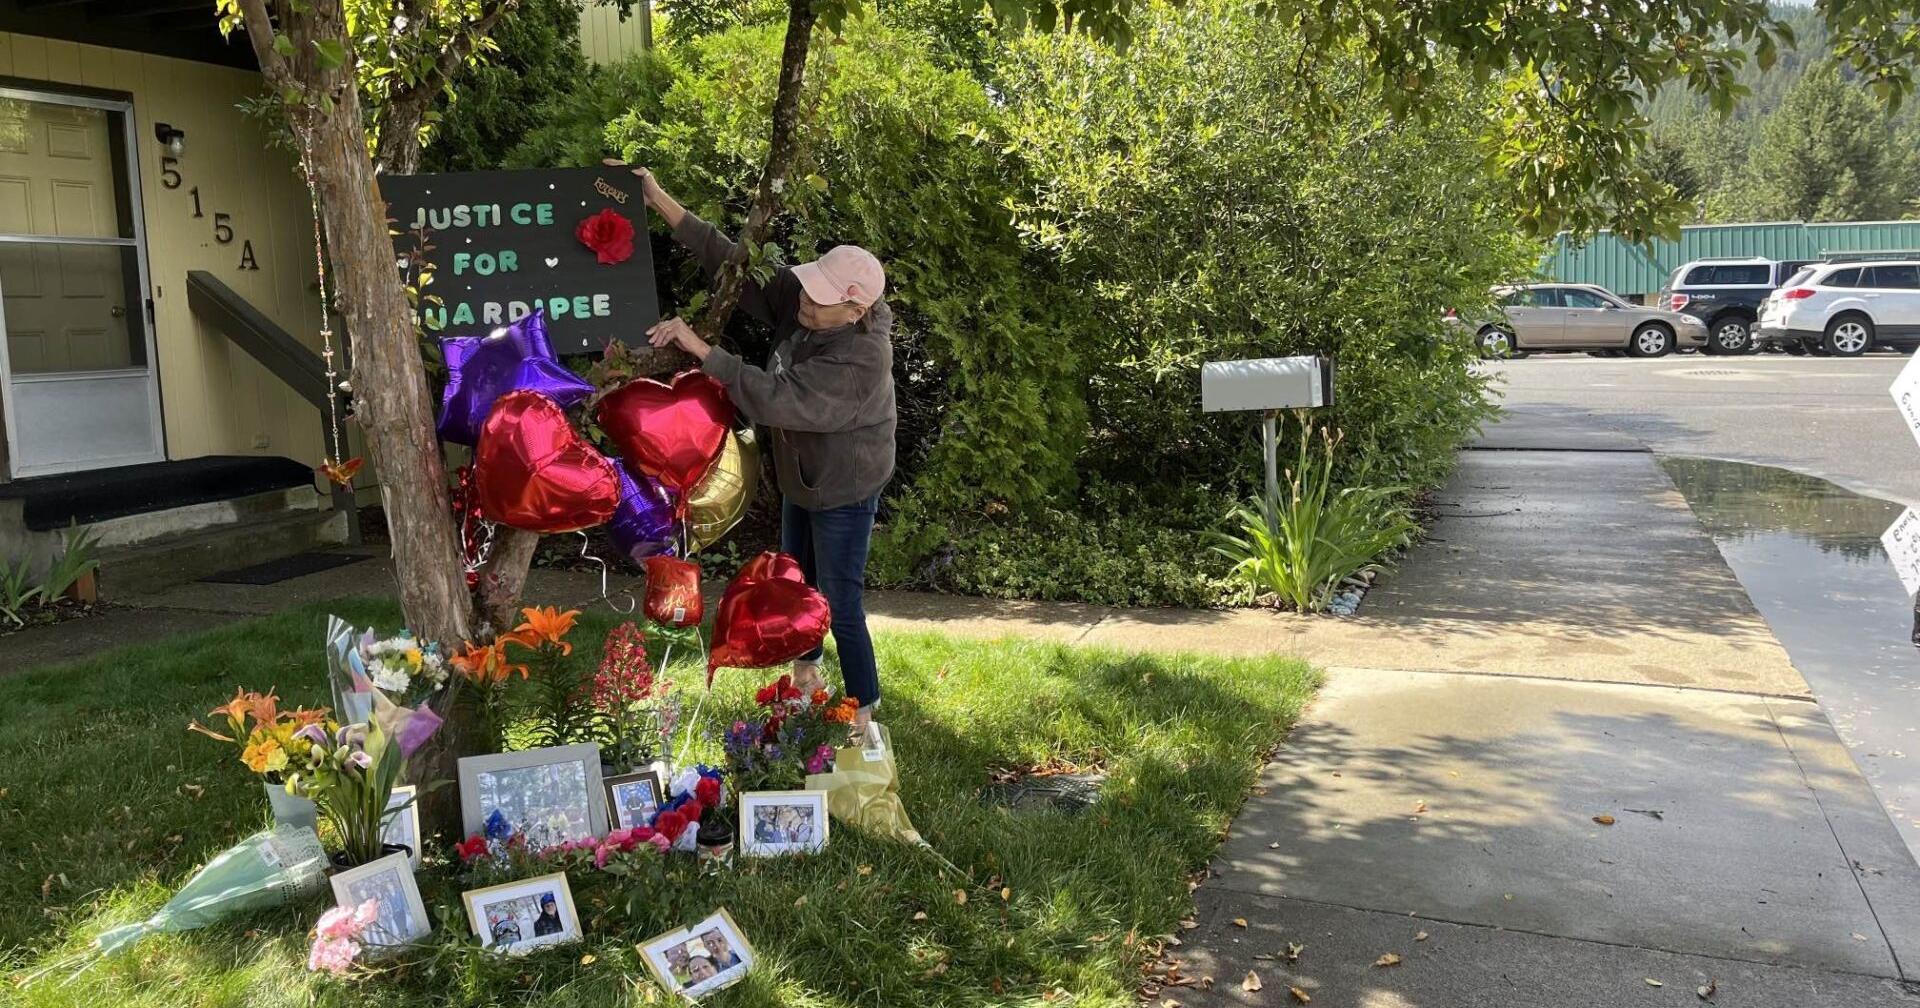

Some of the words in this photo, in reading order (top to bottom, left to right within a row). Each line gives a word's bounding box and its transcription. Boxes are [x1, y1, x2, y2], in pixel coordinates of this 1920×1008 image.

[410, 203, 554, 230] JUSTICE
[453, 250, 519, 276] FOR
[424, 293, 611, 331] UARDPEE
